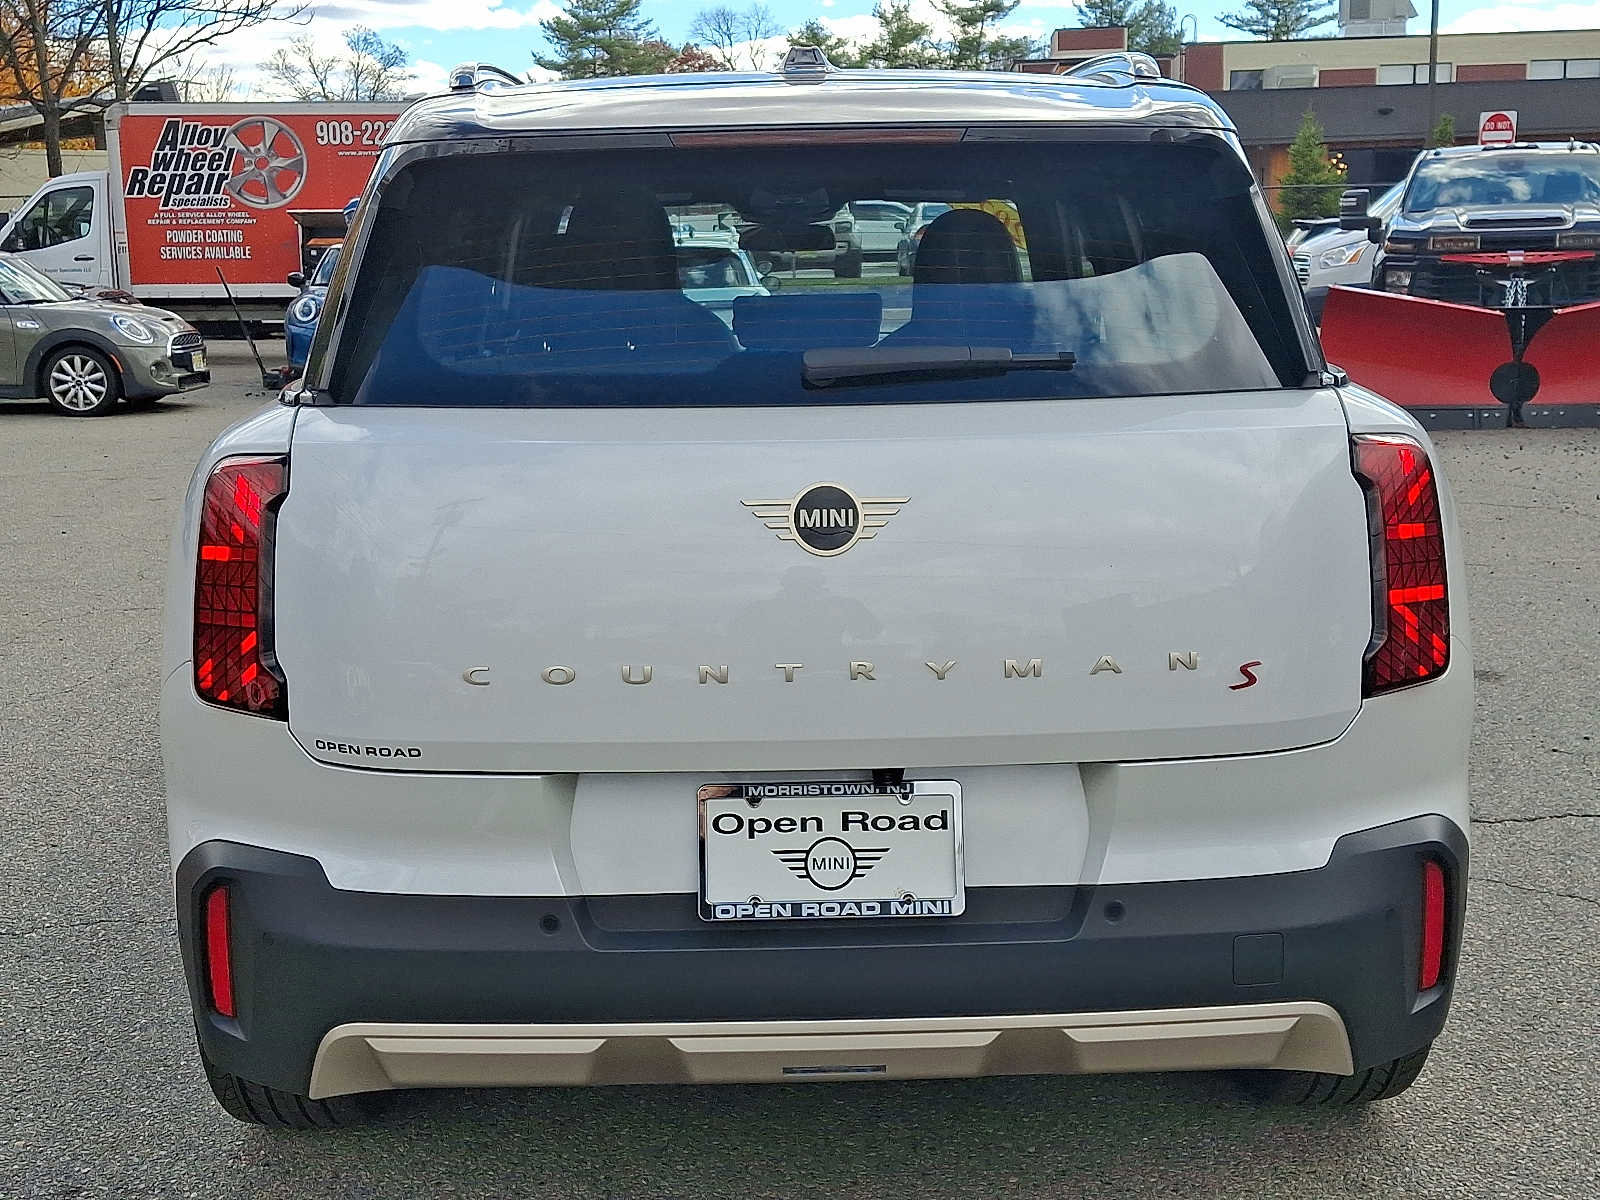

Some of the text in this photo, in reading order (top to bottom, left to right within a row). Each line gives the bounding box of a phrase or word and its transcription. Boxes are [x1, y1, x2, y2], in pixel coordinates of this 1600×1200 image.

[1485, 121, 1510, 130] DO NOT
[157, 119, 228, 152] Alloy
[152, 147, 236, 172] wheel
[126, 168, 230, 207] Repair
[170, 196, 229, 208] specialists
[166, 230, 243, 243] POWDER COATING
[160, 246, 252, 259] SERVICES AVAILABLE
[799, 508, 854, 528] MINI
[462, 650, 1263, 691] COUNTRYMAN S
[315, 739, 422, 758] OPEN ROAD
[886, 783, 911, 795] NJ
[712, 810, 948, 840] Open Road
[812, 856, 850, 871] MINI
[715, 900, 950, 918] OPEN ROAD MINI
